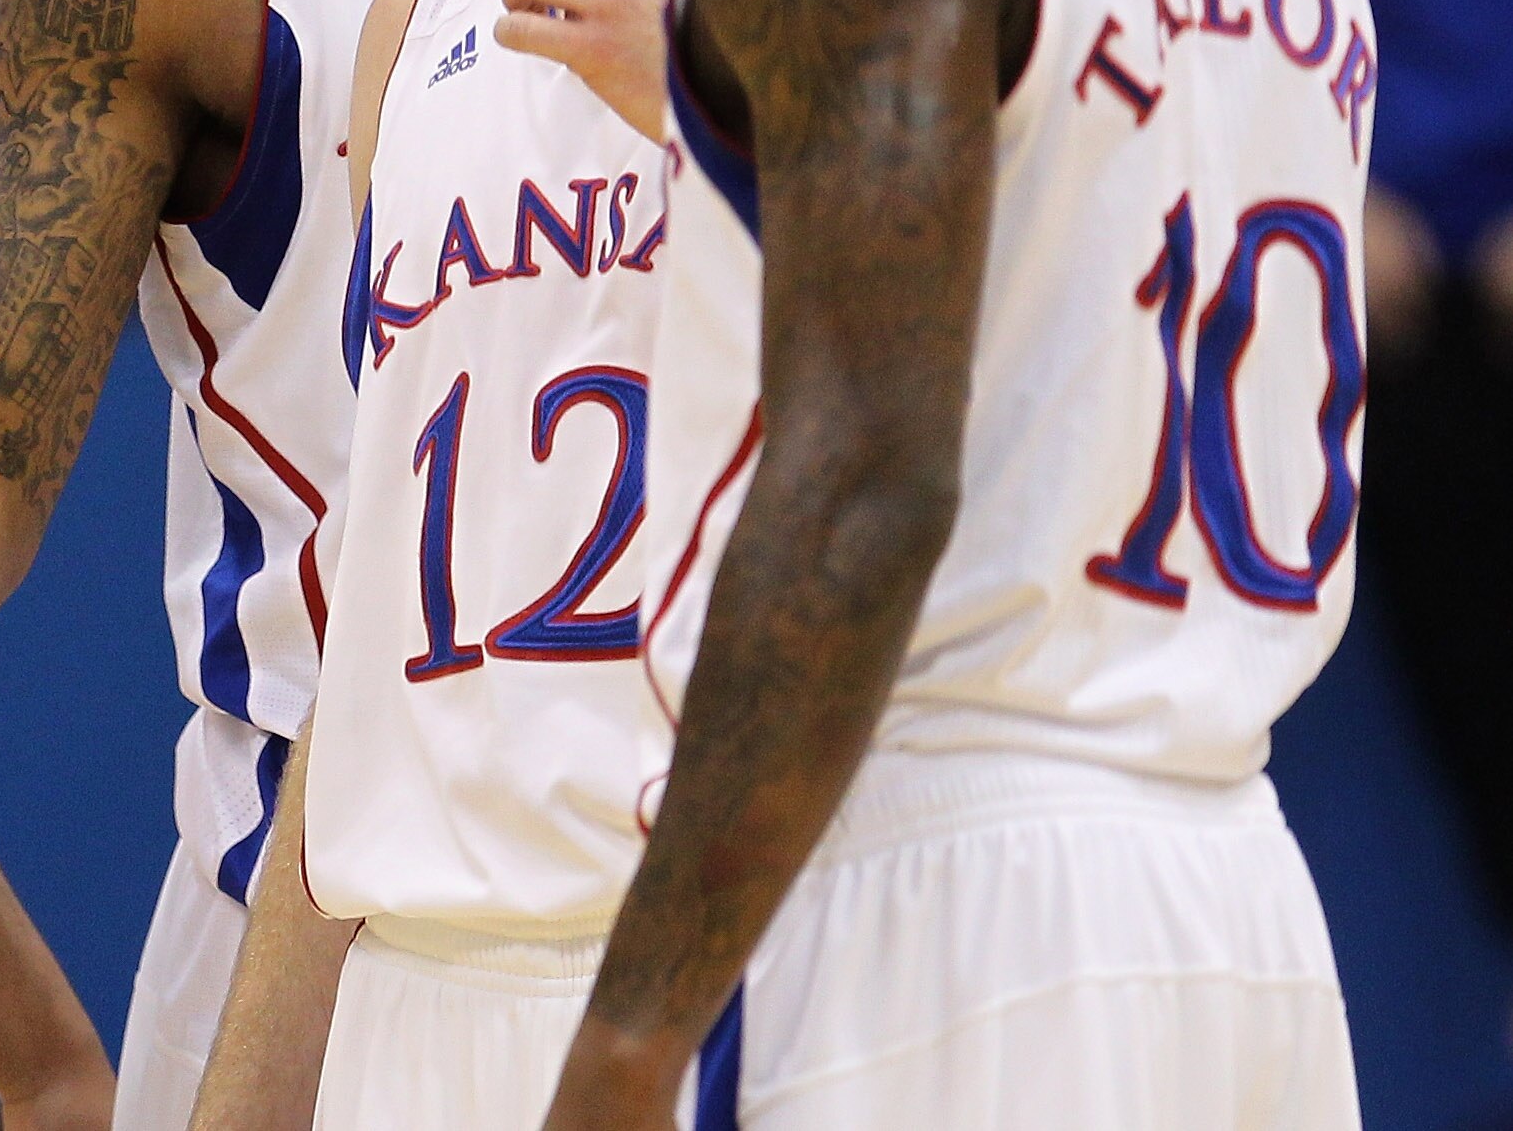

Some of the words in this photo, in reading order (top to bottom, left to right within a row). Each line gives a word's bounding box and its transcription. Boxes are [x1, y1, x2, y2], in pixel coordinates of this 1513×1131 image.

[427, 52, 479, 90] adidas
[406, 364, 649, 682] 12
[1084, 190, 1368, 613] 10
